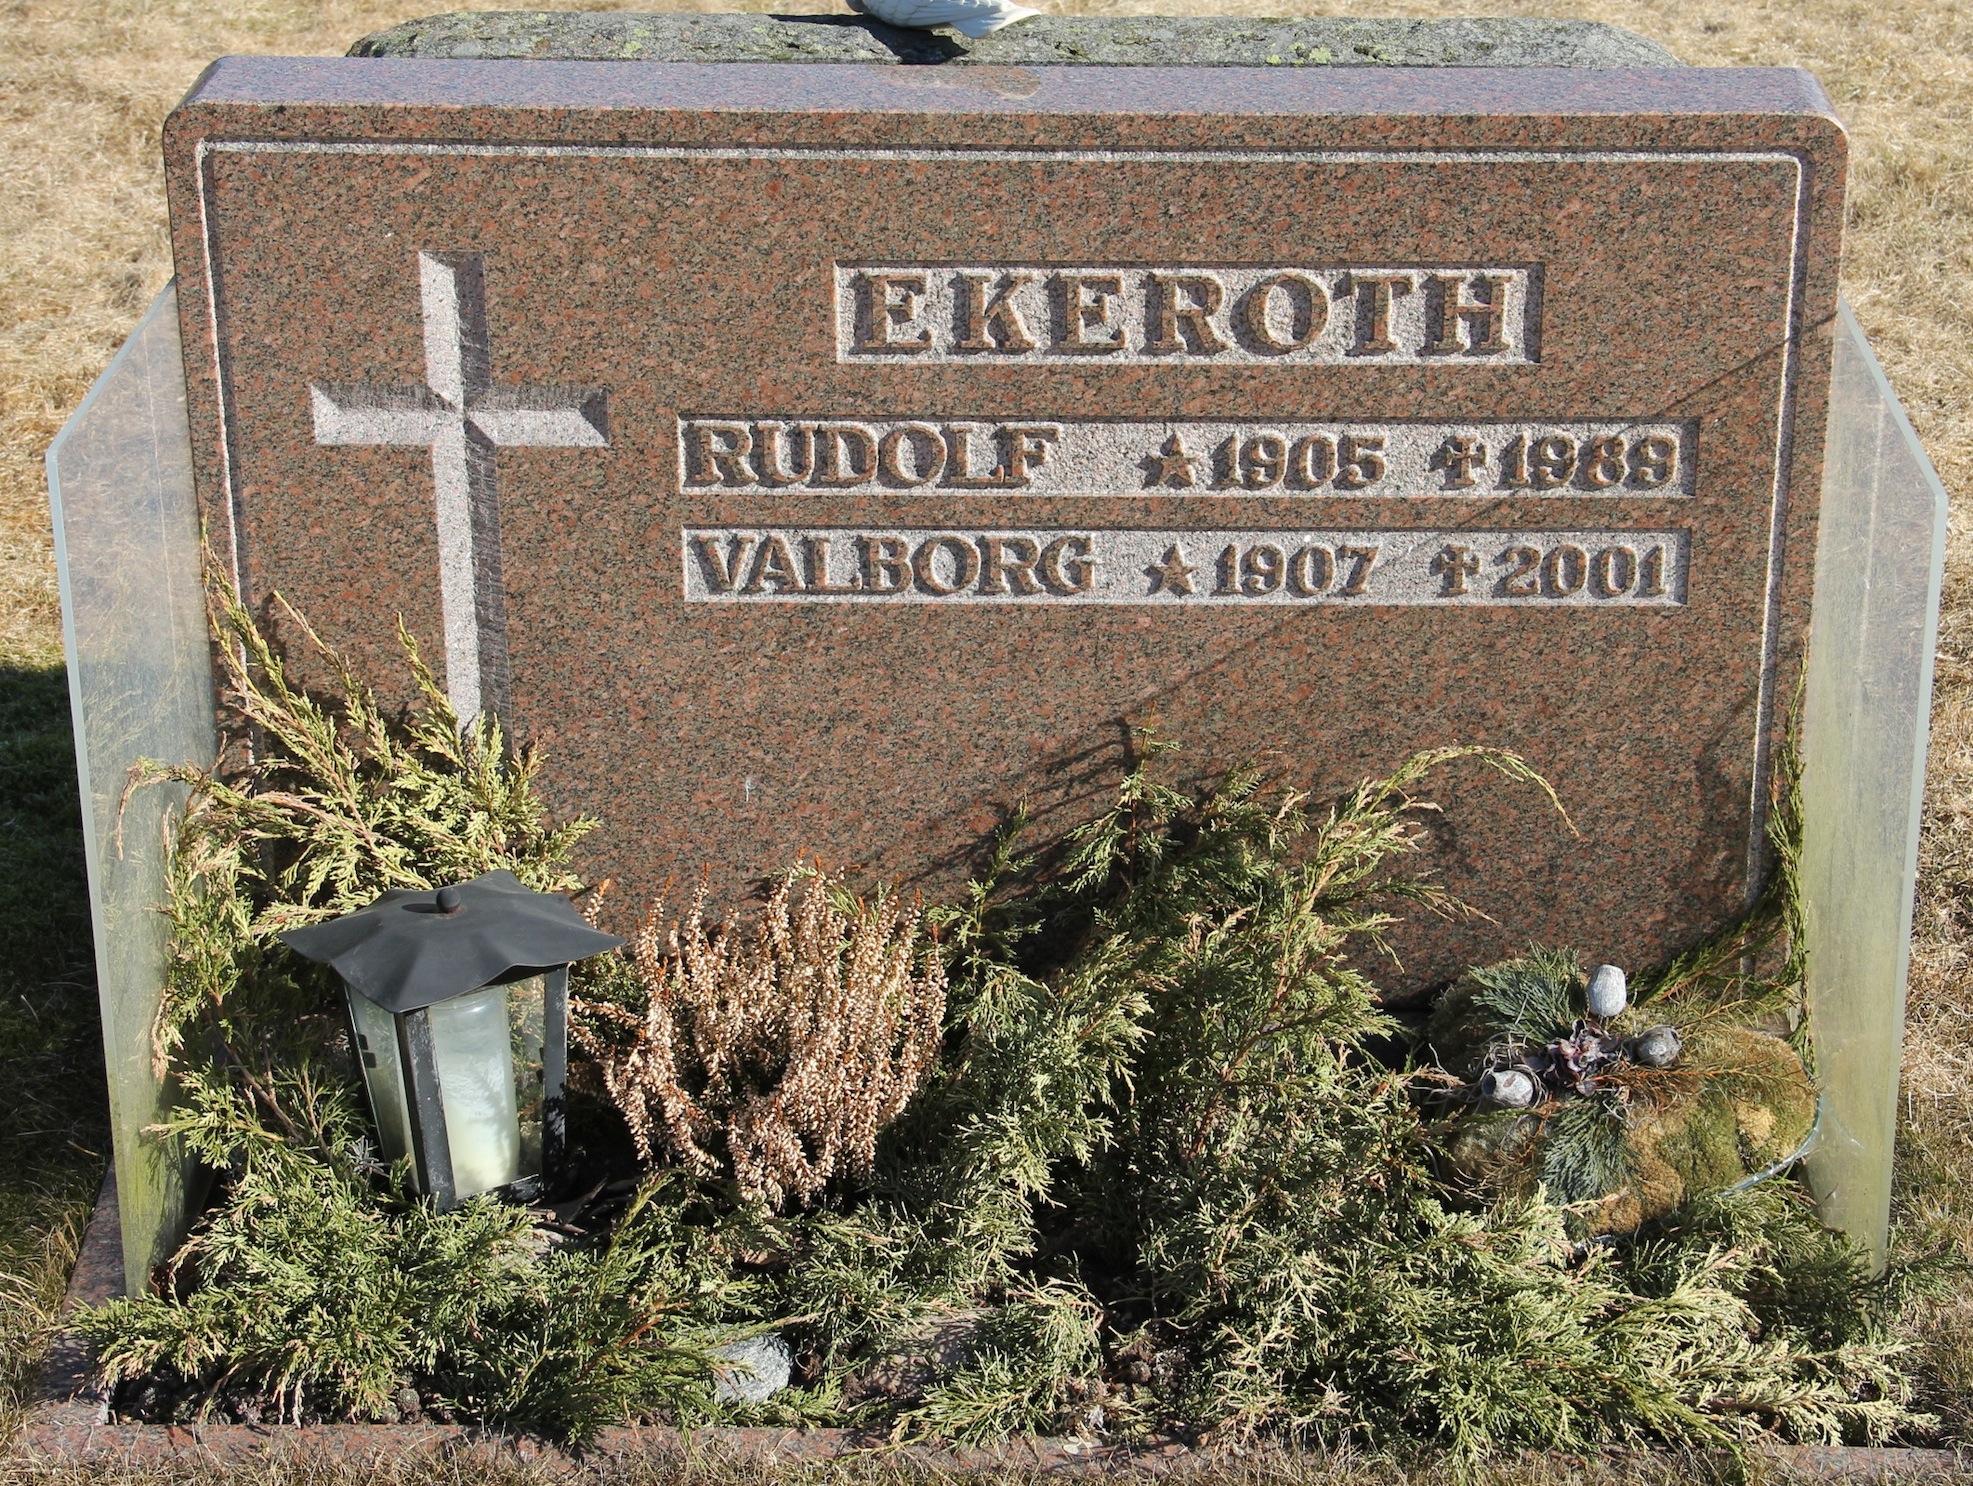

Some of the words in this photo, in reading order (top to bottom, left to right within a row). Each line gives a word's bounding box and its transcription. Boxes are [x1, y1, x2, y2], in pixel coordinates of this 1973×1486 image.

[858, 269, 1517, 354] EKEROTH
[692, 421, 1063, 486] RUDOLF
[1210, 430, 1388, 488] 1905
[1502, 431, 1680, 488] 1989
[694, 532, 1098, 595] VALBORG
[1212, 542, 1382, 596] 1907
[1498, 543, 1668, 596] 2001
